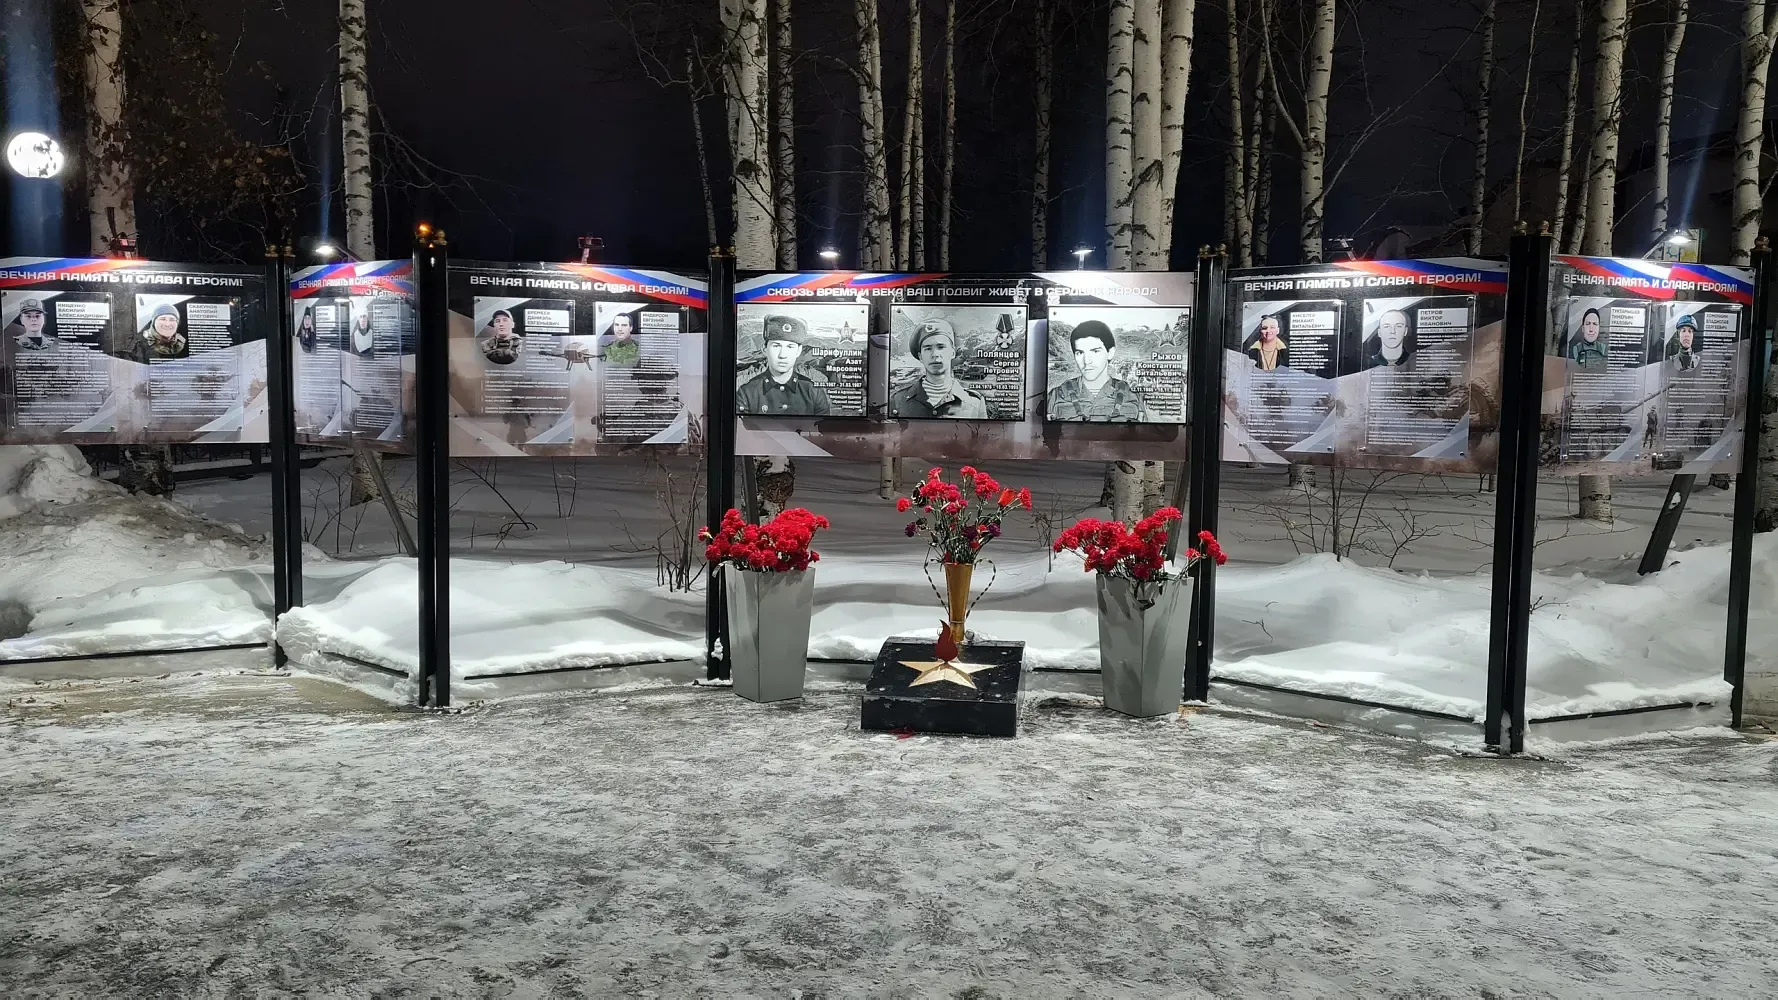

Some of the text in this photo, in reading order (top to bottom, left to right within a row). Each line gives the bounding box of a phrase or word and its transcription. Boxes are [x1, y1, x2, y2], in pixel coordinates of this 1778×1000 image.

[0, 270, 244, 287] ВЕЧНАЯ ПАМЯТЬ И СЛАВА ГЕРОЯМ!
[1244, 273, 1481, 291] ВЕЧНАЯ ПАМЯТЬ И СЛАВА ГЕРОЯМ!
[1563, 273, 1738, 293] ВЕЧНАЯ ПАМЯТЬ И СЛАВА ГЕРОЯМ!
[298, 279, 322, 289] ВЕЧНАЯ
[470, 275, 689, 295] ВЕЧНАЯ ПАМЯТЬ И СЛАВА ГЕРОЯМ!
[767, 287, 815, 297] СКВОЗЬ
[816, 287, 858, 297] ВРЕМЯ
[859, 287, 869, 297] И
[872, 287, 903, 297] ВЕКА
[907, 287, 934, 297] ВАШ
[937, 287, 984, 297] ПОДВИГ
[1034, 287, 1043, 296] В
[1107, 287, 1158, 296] НАРОДА
[812, 347, 862, 357] Шарифуллин
[977, 350, 1019, 358] Полянцев
[1151, 352, 1182, 360] Рыжов
[983, 367, 1019, 375] Петрович
